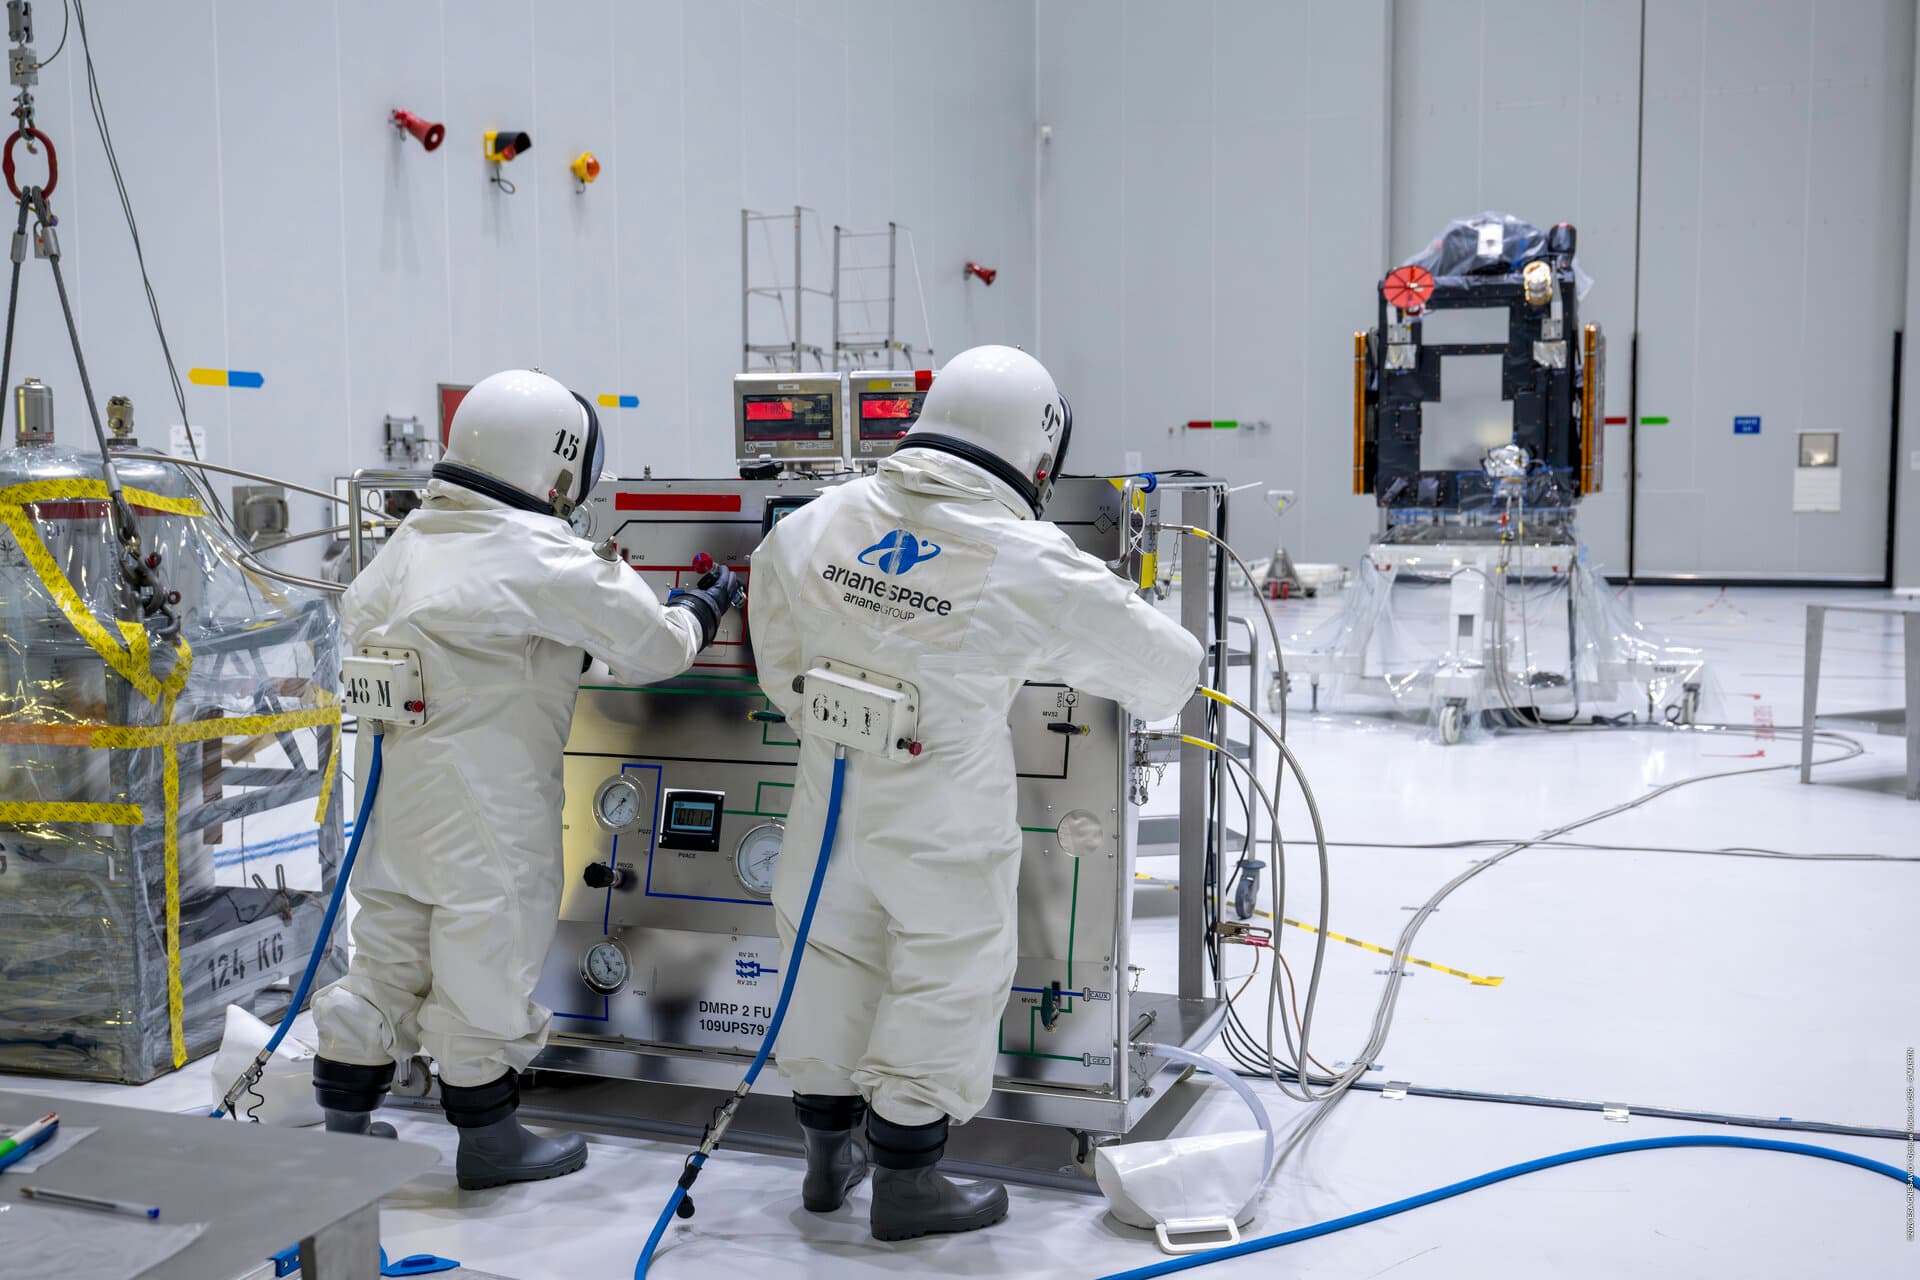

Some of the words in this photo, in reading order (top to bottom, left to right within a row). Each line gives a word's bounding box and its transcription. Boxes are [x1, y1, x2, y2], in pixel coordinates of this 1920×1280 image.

[553, 428, 580, 462] 15
[822, 563, 952, 616] arianespace
[347, 677, 370, 704] 48
[376, 680, 392, 708] M
[208, 948, 245, 991] 124
[258, 932, 283, 971] KG
[699, 1000, 738, 1016] DMRP
[742, 1004, 750, 1017] 2
[699, 1018, 770, 1036] 109UPS79
